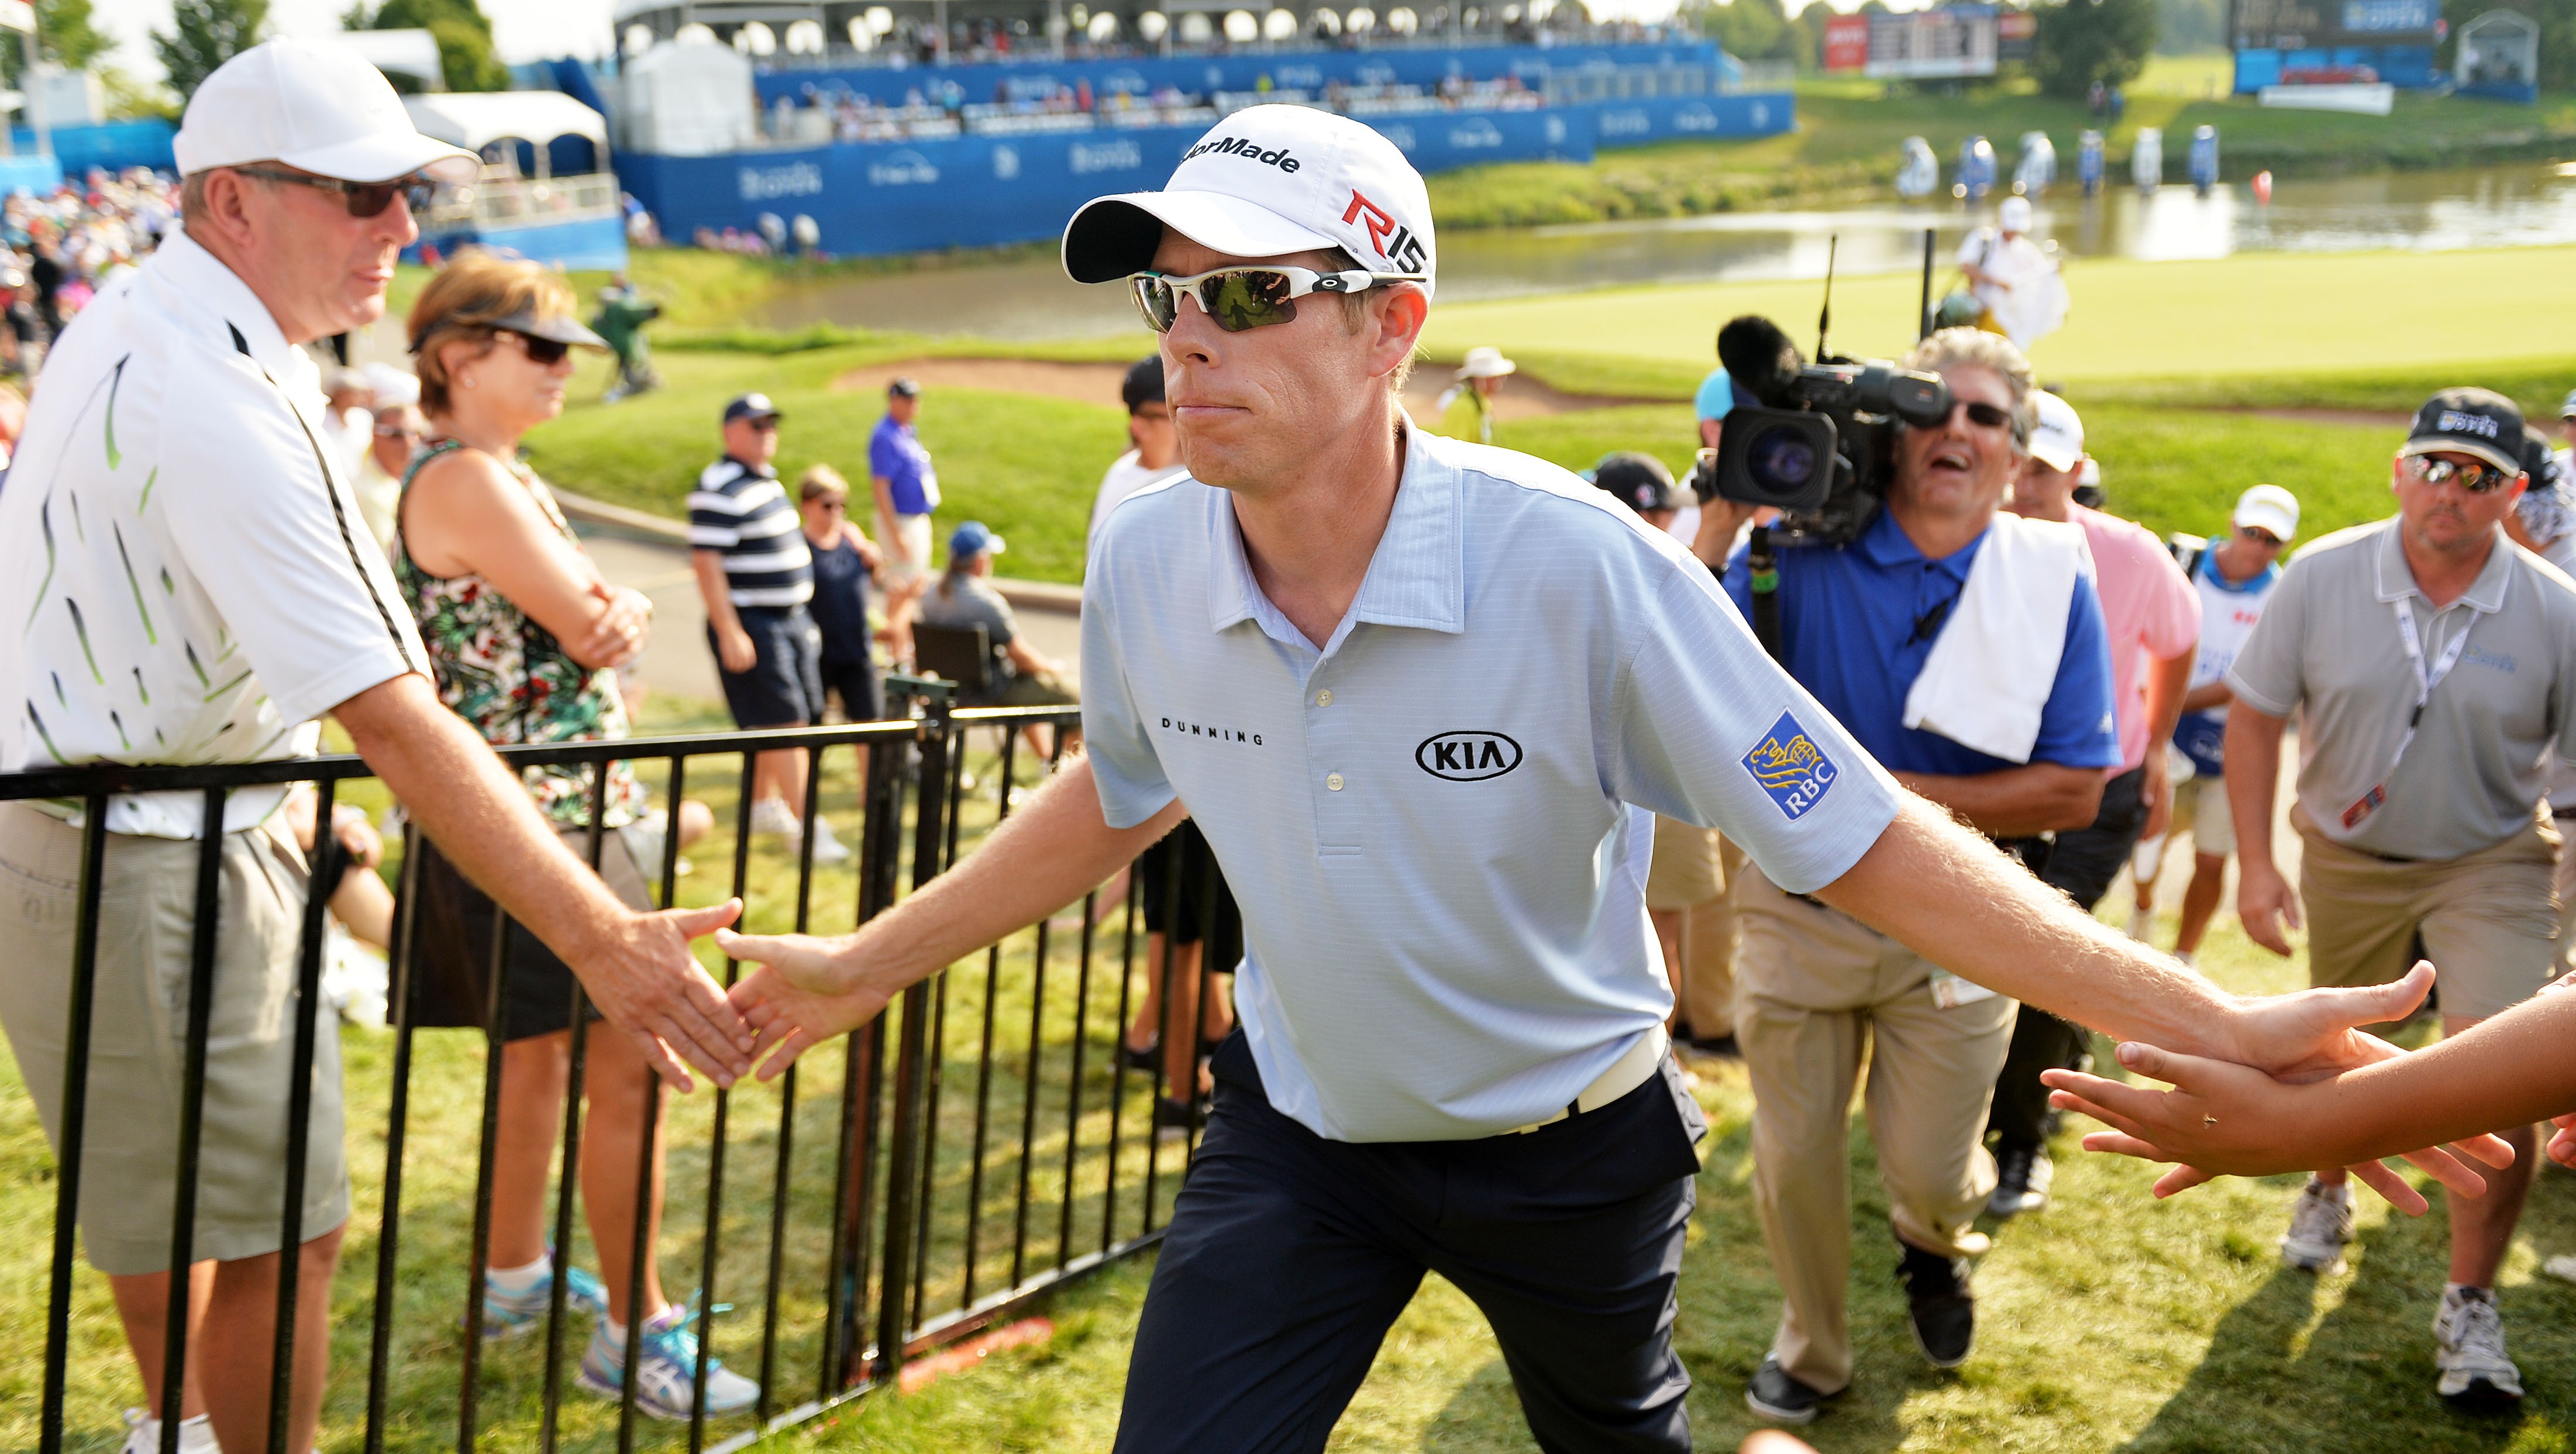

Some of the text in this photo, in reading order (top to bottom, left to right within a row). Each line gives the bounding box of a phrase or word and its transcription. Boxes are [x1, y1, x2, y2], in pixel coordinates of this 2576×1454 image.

[1342, 188, 1427, 274] R15
[1162, 718, 1262, 746] DUNNING
[1433, 740, 1506, 770] KIA
[1785, 762, 1834, 815] RBC
